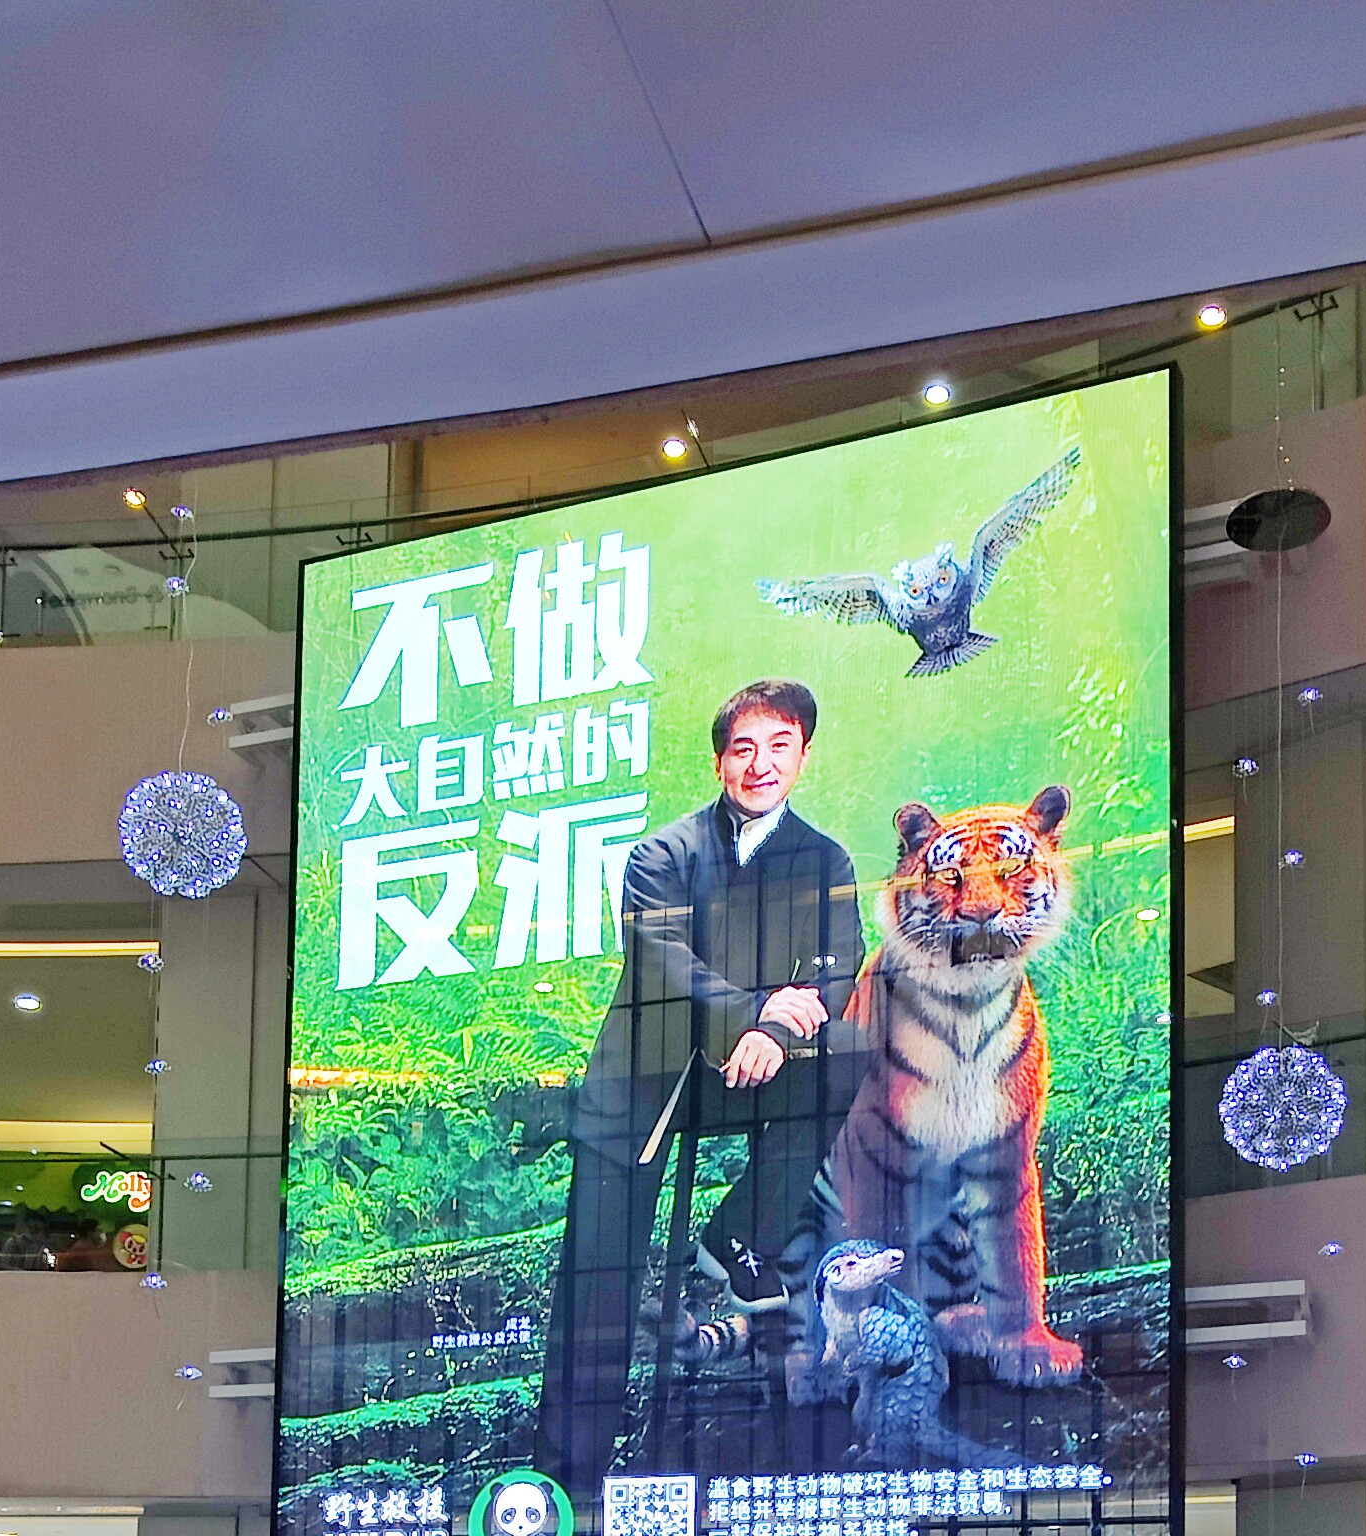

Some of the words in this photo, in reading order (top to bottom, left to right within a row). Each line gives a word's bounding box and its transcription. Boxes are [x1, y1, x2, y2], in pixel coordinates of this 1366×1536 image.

[339, 531, 653, 728] 不做
[339, 699, 650, 830] 大自然的
[335, 793, 648, 992] 反派
[321, 1486, 449, 1528] 野生救援
[708, 1464, 1113, 1499] 滥食野生动物破坏生物安全和生态安全。
